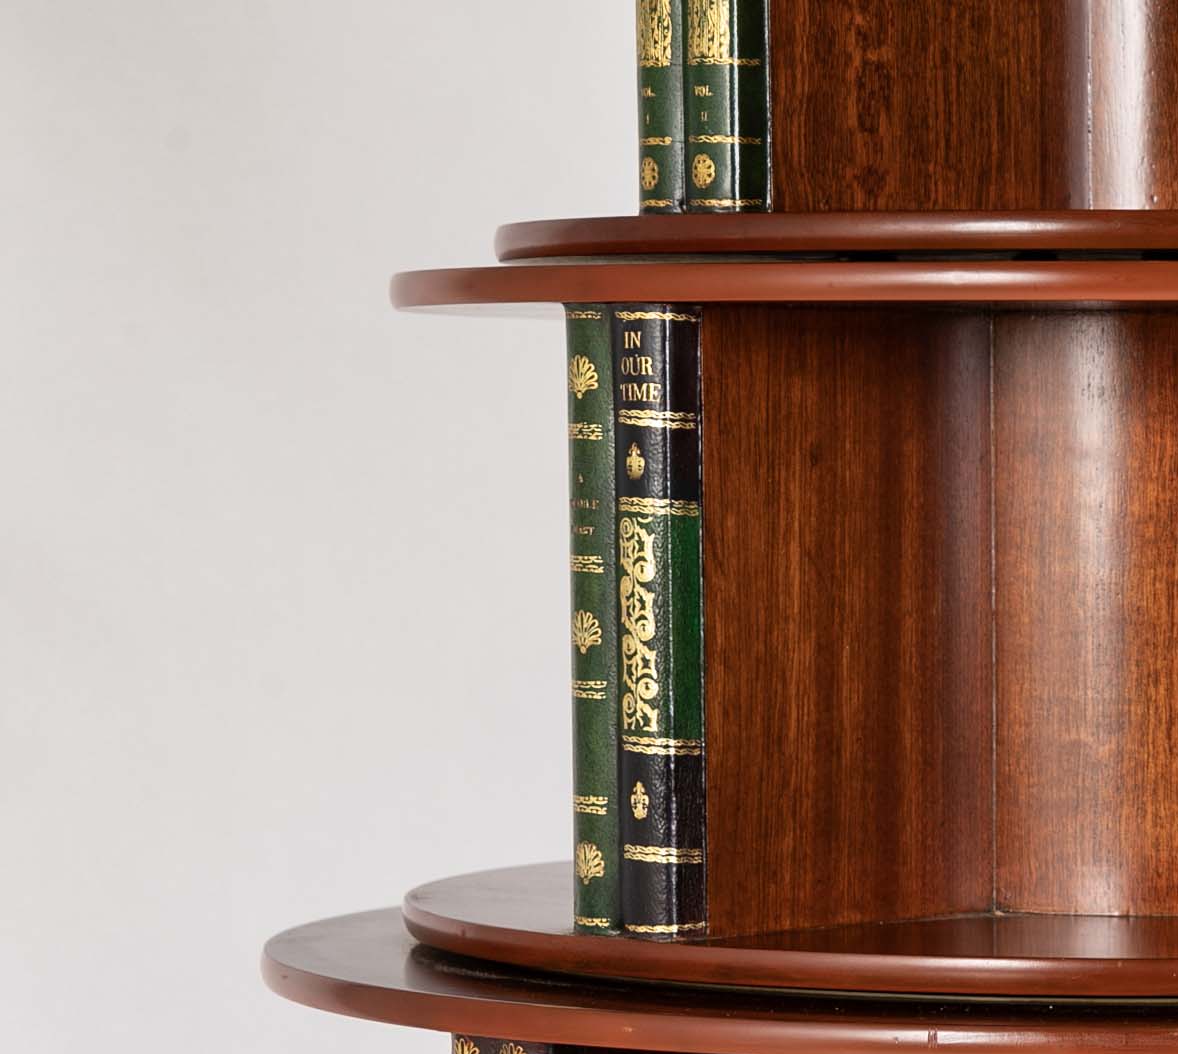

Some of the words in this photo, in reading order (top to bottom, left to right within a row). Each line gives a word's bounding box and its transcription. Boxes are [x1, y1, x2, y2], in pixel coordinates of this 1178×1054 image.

[624, 331, 641, 349] IN
[621, 356, 654, 376] OUR
[620, 383, 662, 402] TIME
